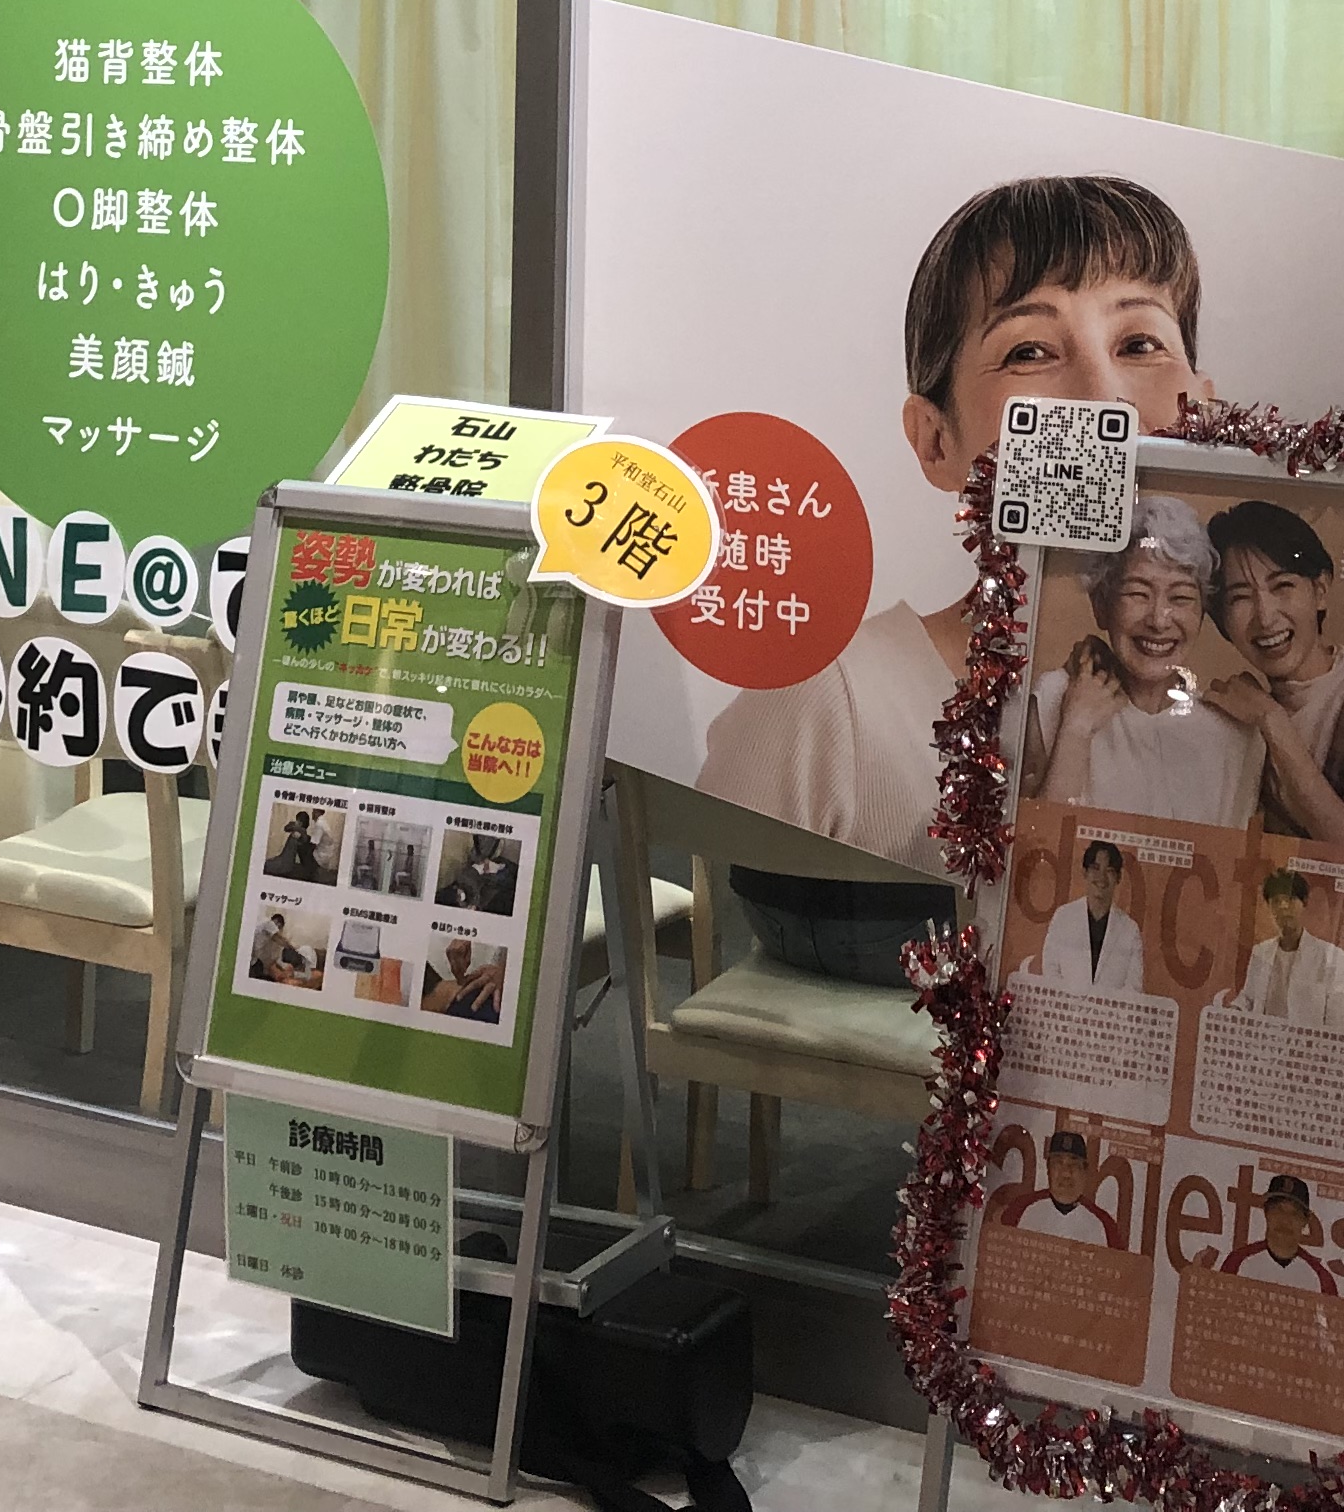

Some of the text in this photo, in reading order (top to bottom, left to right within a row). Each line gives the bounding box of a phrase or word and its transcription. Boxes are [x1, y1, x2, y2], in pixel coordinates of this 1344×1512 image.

[54, 39, 224, 87] 猫背整体
[38, 261, 226, 315] はり・きゅう
[69, 333, 195, 387] 美顔鍼
[42, 415, 221, 463] マッサージ
[451, 415, 517, 441] 石山
[414, 444, 508, 471] わだち
[1043, 462, 1084, 481] LINE
[387, 473, 488, 498] 整骨院
[611, 451, 687, 515] 平和堂石山
[565, 481, 678, 581] 3階
[718, 529, 792, 575] 随時
[290, 530, 504, 599] 姿勢が変われば
[690, 585, 810, 636] 受付中
[269, 758, 337, 779] 治療メニュー
[467, 732, 542, 758] こんな方は
[233, 1150, 256, 1167] 平日
[288, 1119, 384, 1167] 診療時間
[281, 1263, 305, 1281] 休診
